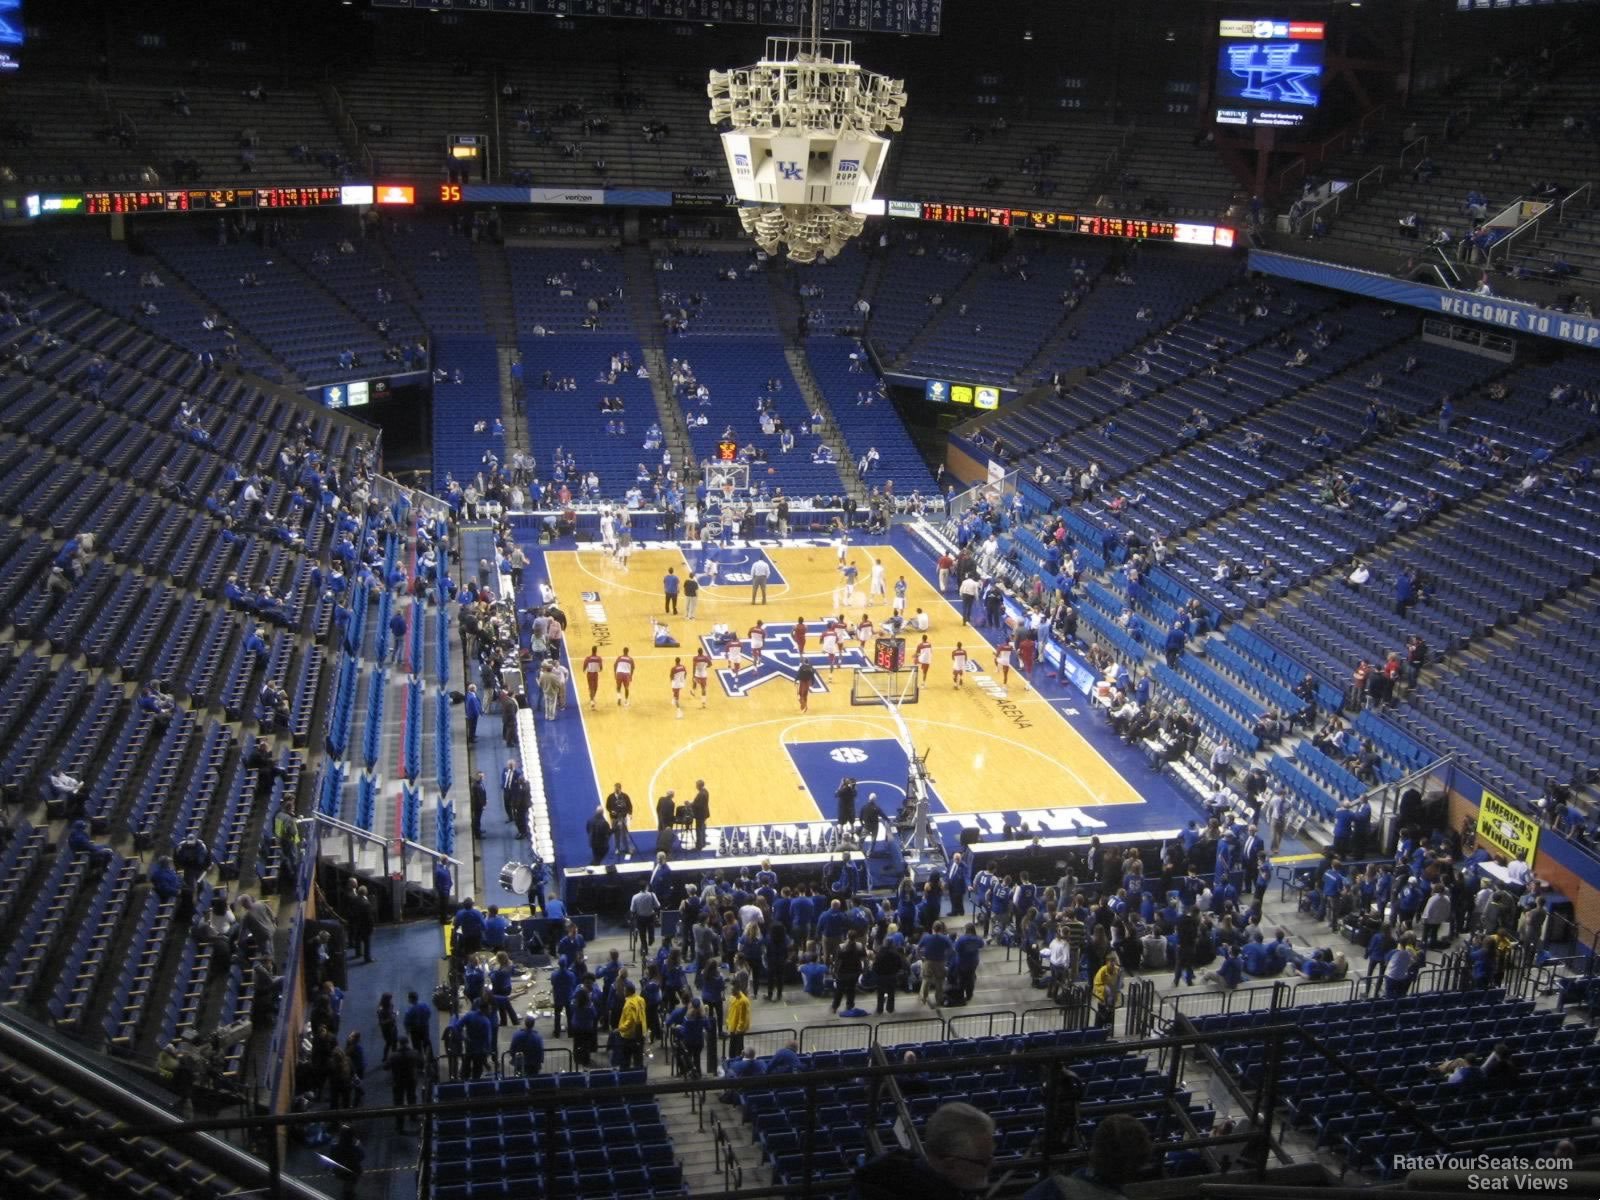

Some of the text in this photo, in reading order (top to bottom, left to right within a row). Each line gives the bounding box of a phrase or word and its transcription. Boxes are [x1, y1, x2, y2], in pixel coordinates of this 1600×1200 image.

[1227, 43, 1322, 106] UK
[776, 160, 804, 180] UK
[441, 186, 460, 201] 35
[564, 193, 593, 202] verizon
[1440, 296, 1519, 326] WELCOME
[1528, 314, 1550, 333] TO
[877, 652, 891, 669] 35
[992, 699, 1033, 730] ARENA
[1485, 797, 1534, 842] AMERICA'S
[996, 888, 1007, 897] 12
